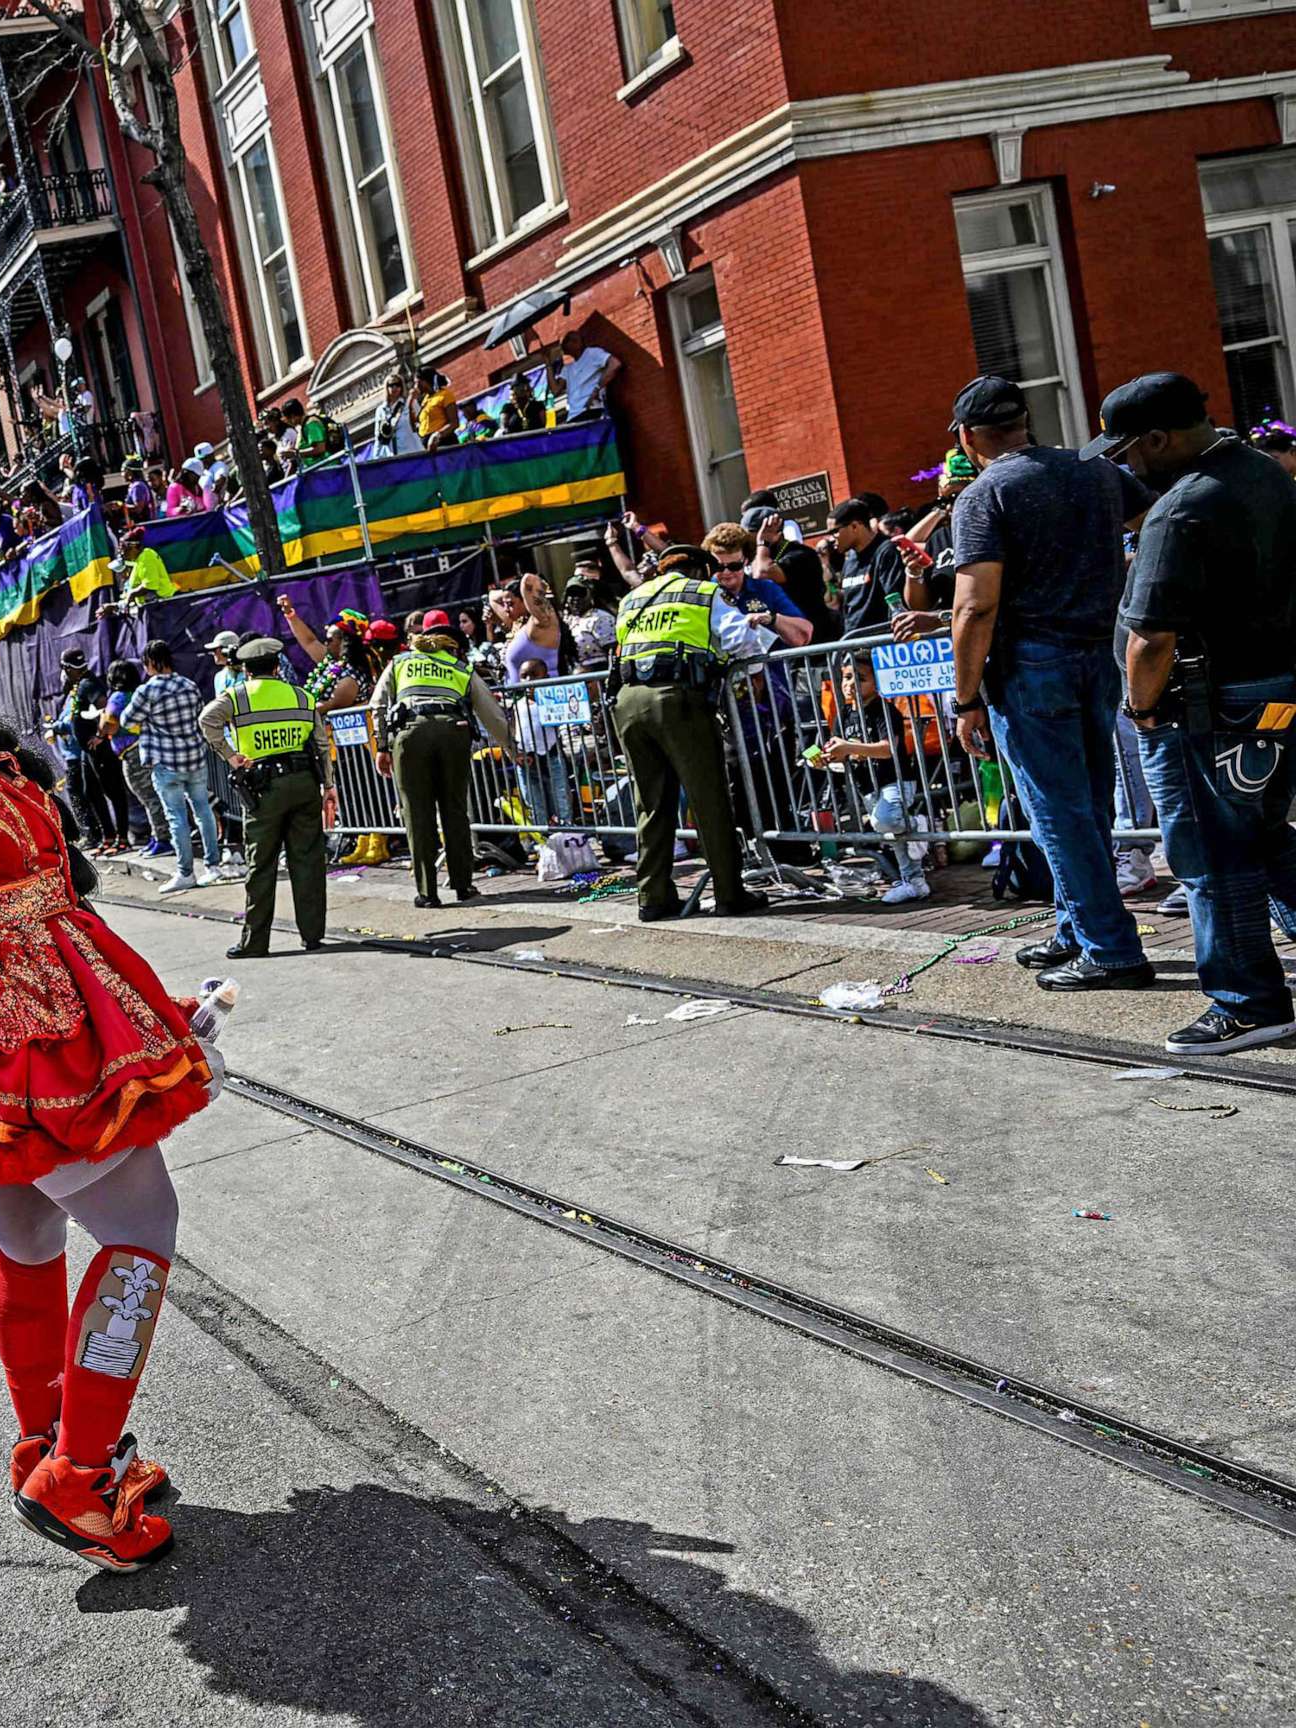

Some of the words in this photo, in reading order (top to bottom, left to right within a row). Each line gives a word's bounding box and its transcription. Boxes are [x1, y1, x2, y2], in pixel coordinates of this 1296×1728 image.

[773, 481, 822, 501] LOUISIANA
[791, 490, 827, 509] CENTER
[626, 610, 680, 633] SERIFF
[894, 666, 933, 680] POLICE
[940, 664, 955, 676] LIN
[889, 681, 904, 691] DO
[911, 678, 932, 689] NOT
[254, 727, 302, 751] SHERIFF
